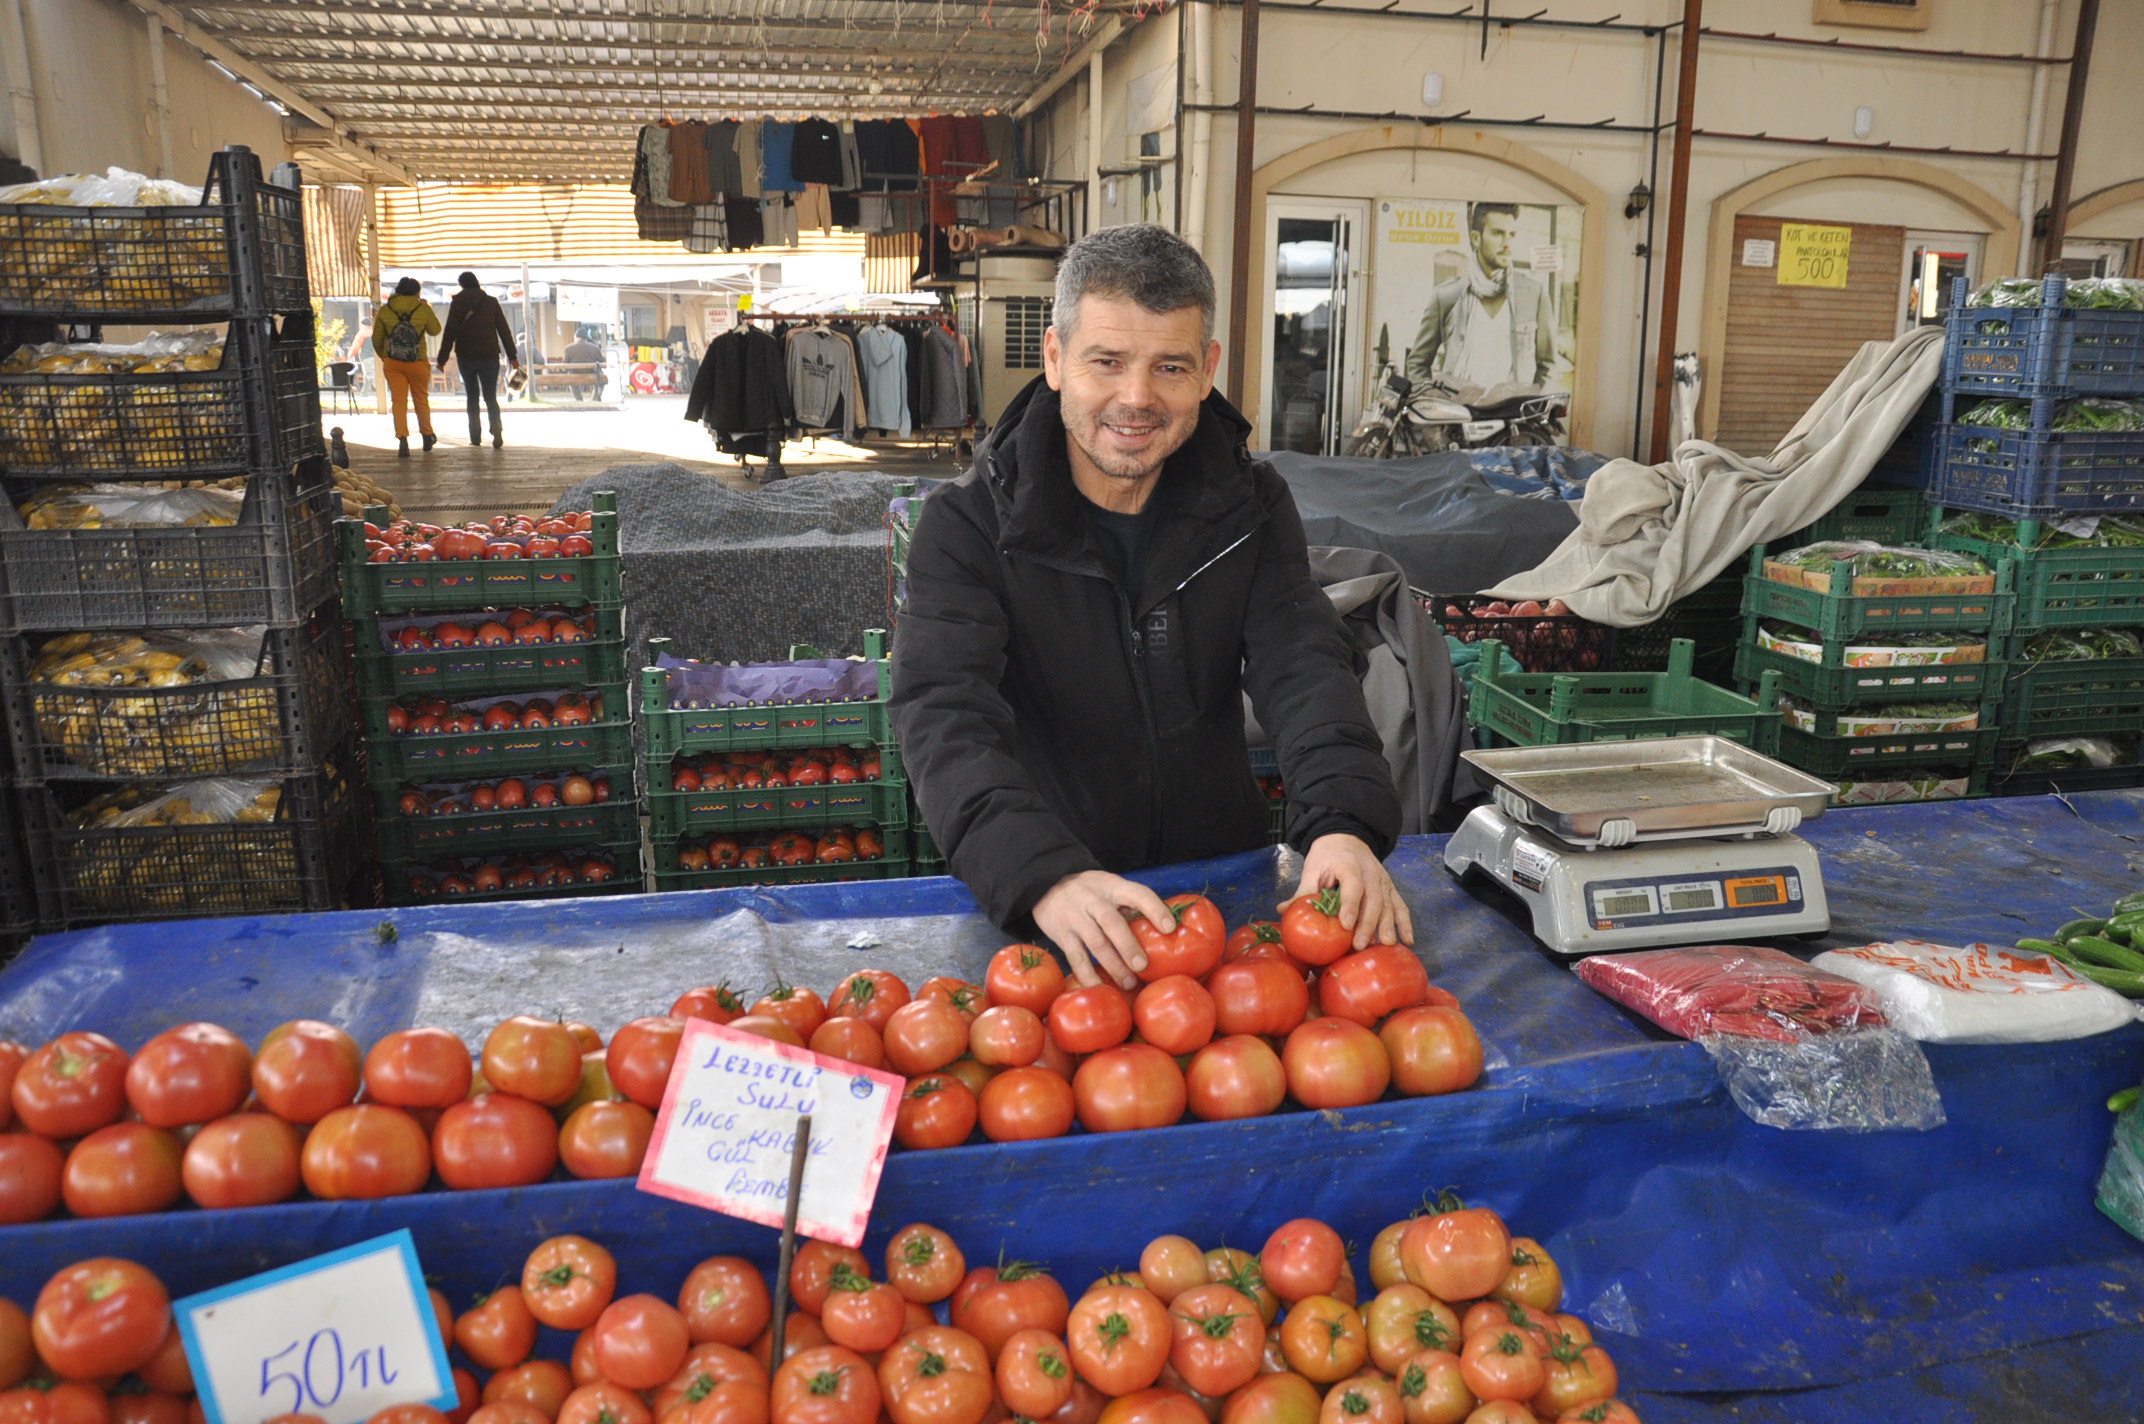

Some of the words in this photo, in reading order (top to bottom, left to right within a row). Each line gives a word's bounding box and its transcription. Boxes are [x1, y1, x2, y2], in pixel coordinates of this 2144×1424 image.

[1395, 210, 1456, 228] YILDIZ
[1820, 231, 1849, 243] KETEN
[1798, 257, 1835, 280] 500
[681, 1098, 740, 1131] İNCE
